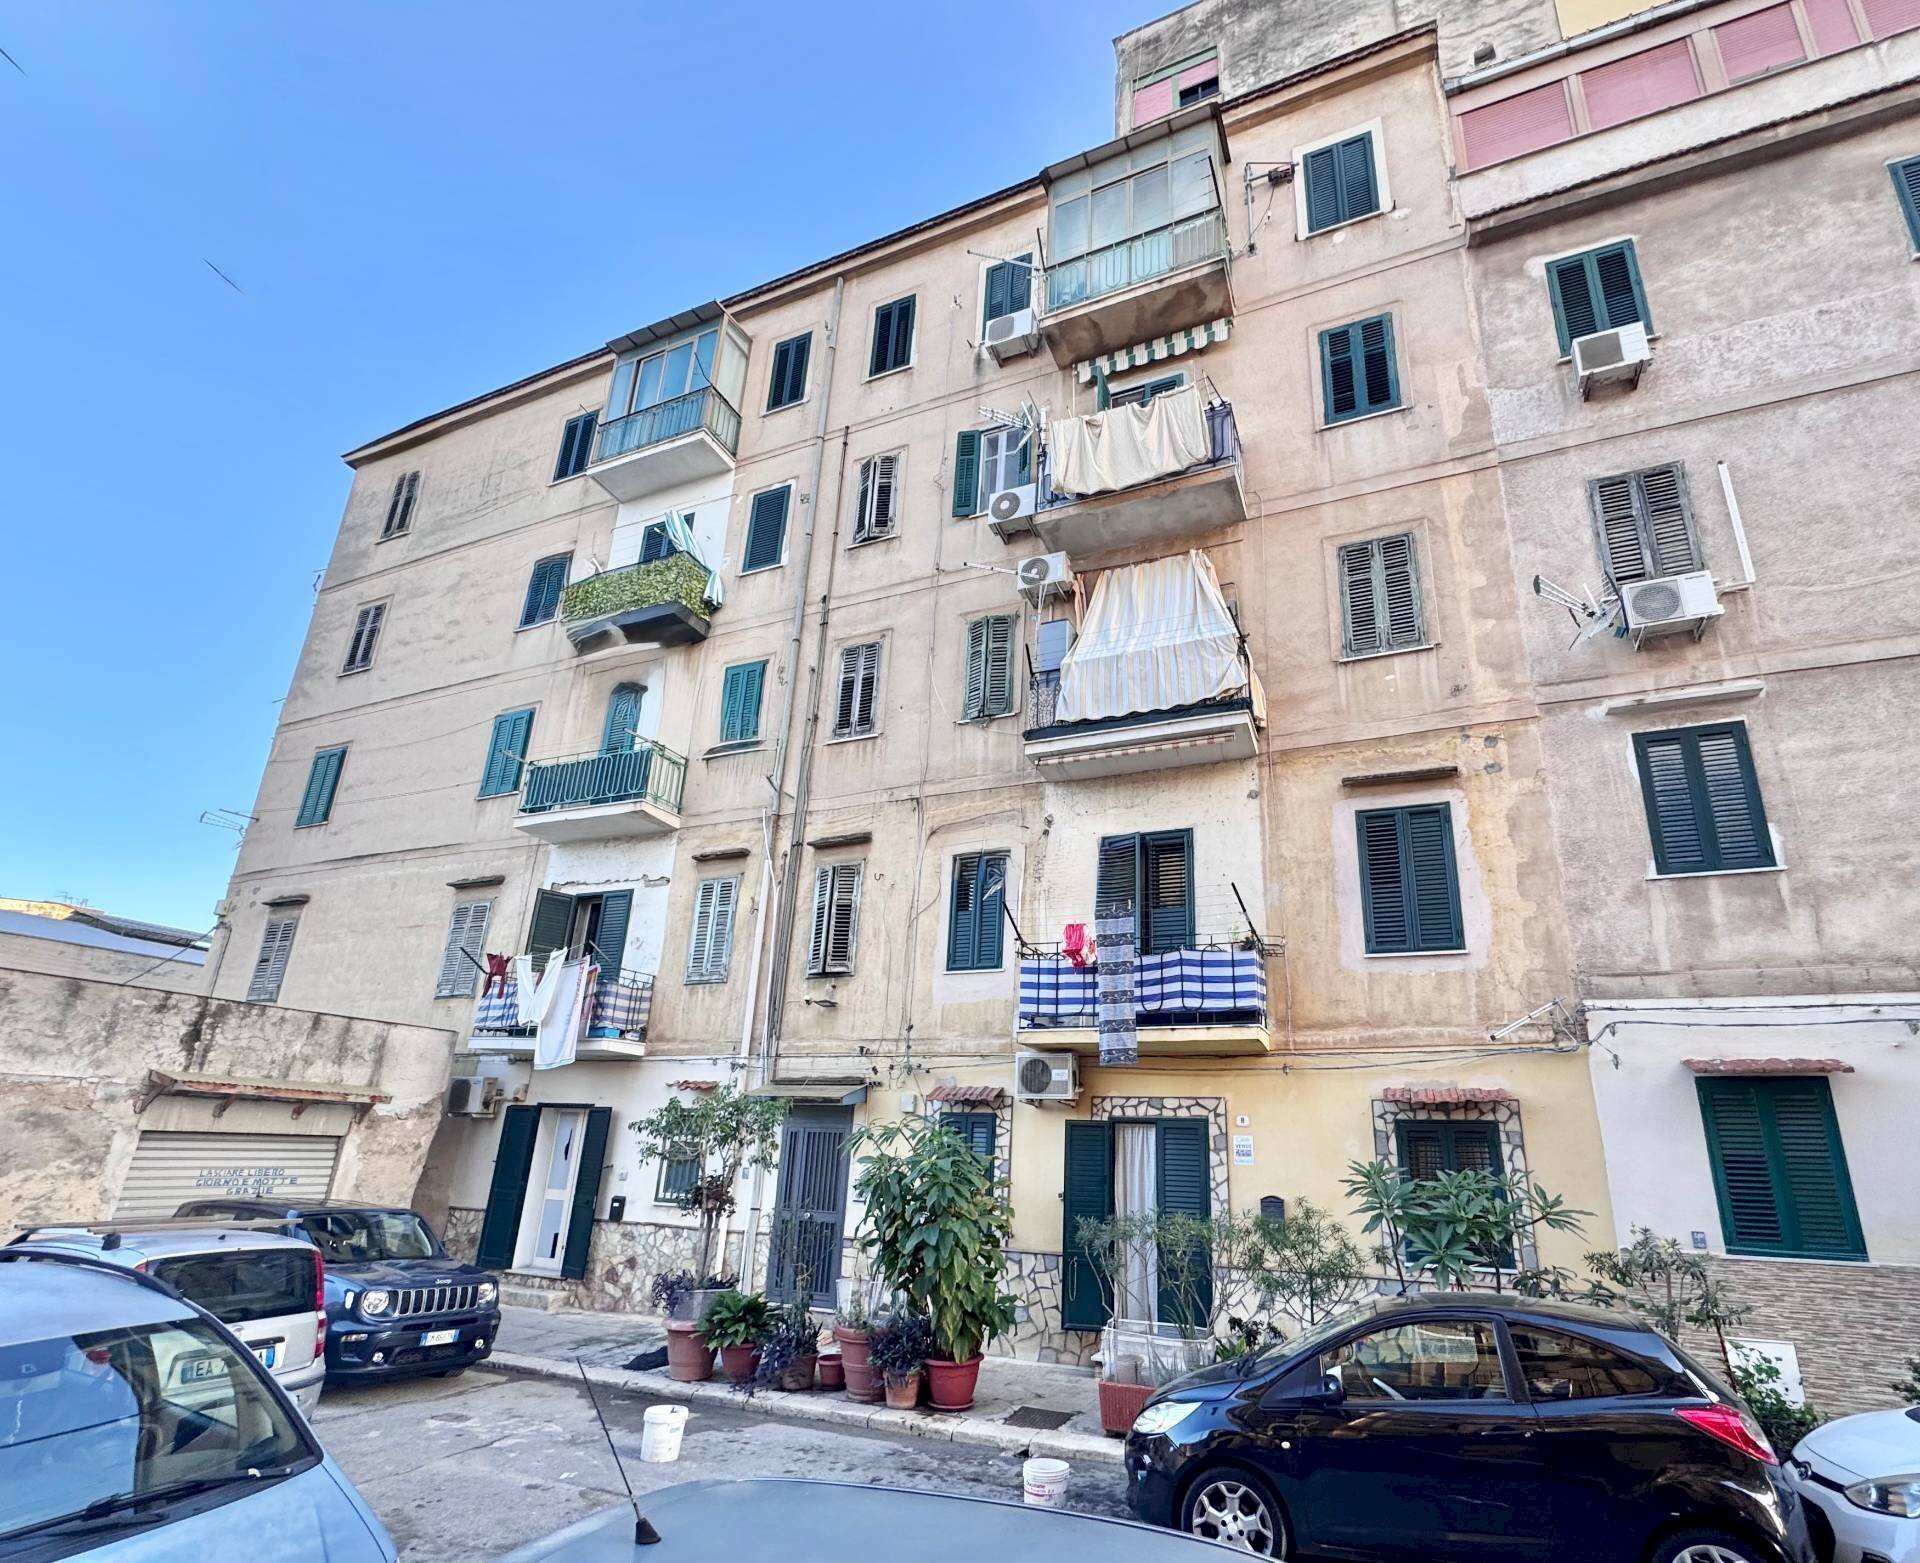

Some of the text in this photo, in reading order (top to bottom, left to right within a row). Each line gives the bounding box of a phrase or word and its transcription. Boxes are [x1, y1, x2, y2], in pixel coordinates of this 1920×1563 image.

[199, 1168, 286, 1178] LASCIARE LIBERO
[195, 1178, 239, 1187] GIORNO
[242, 1178, 249, 1186] E
[226, 1186, 274, 1196] GRAZIE
